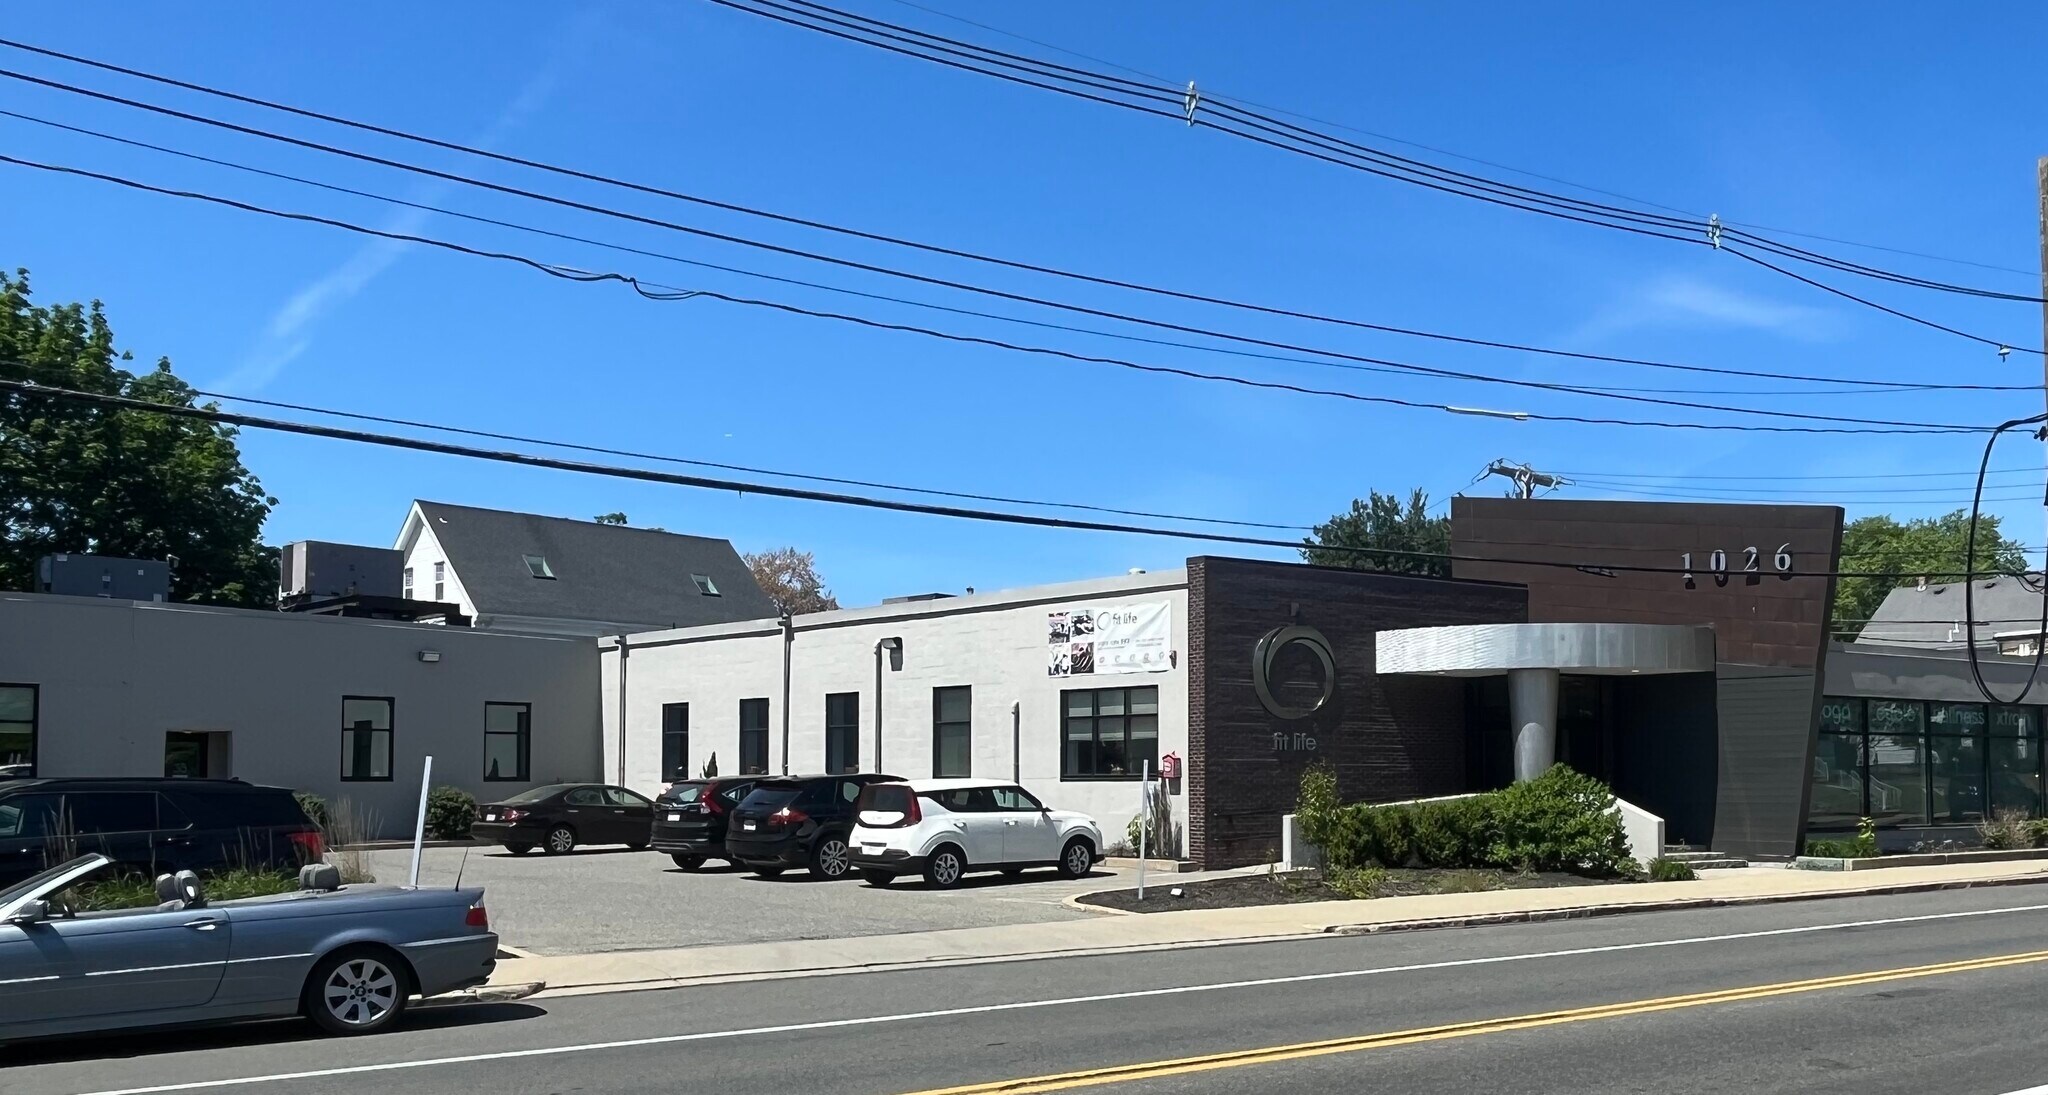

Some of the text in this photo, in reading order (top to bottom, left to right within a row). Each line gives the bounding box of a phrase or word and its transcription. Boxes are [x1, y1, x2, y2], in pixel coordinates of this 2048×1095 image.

[1682, 543, 1791, 580] 1026
[1123, 612, 1138, 625] life
[1821, 705, 1851, 725] oga
[1933, 706, 1985, 725] llness
[1273, 732, 1317, 751] fit life
